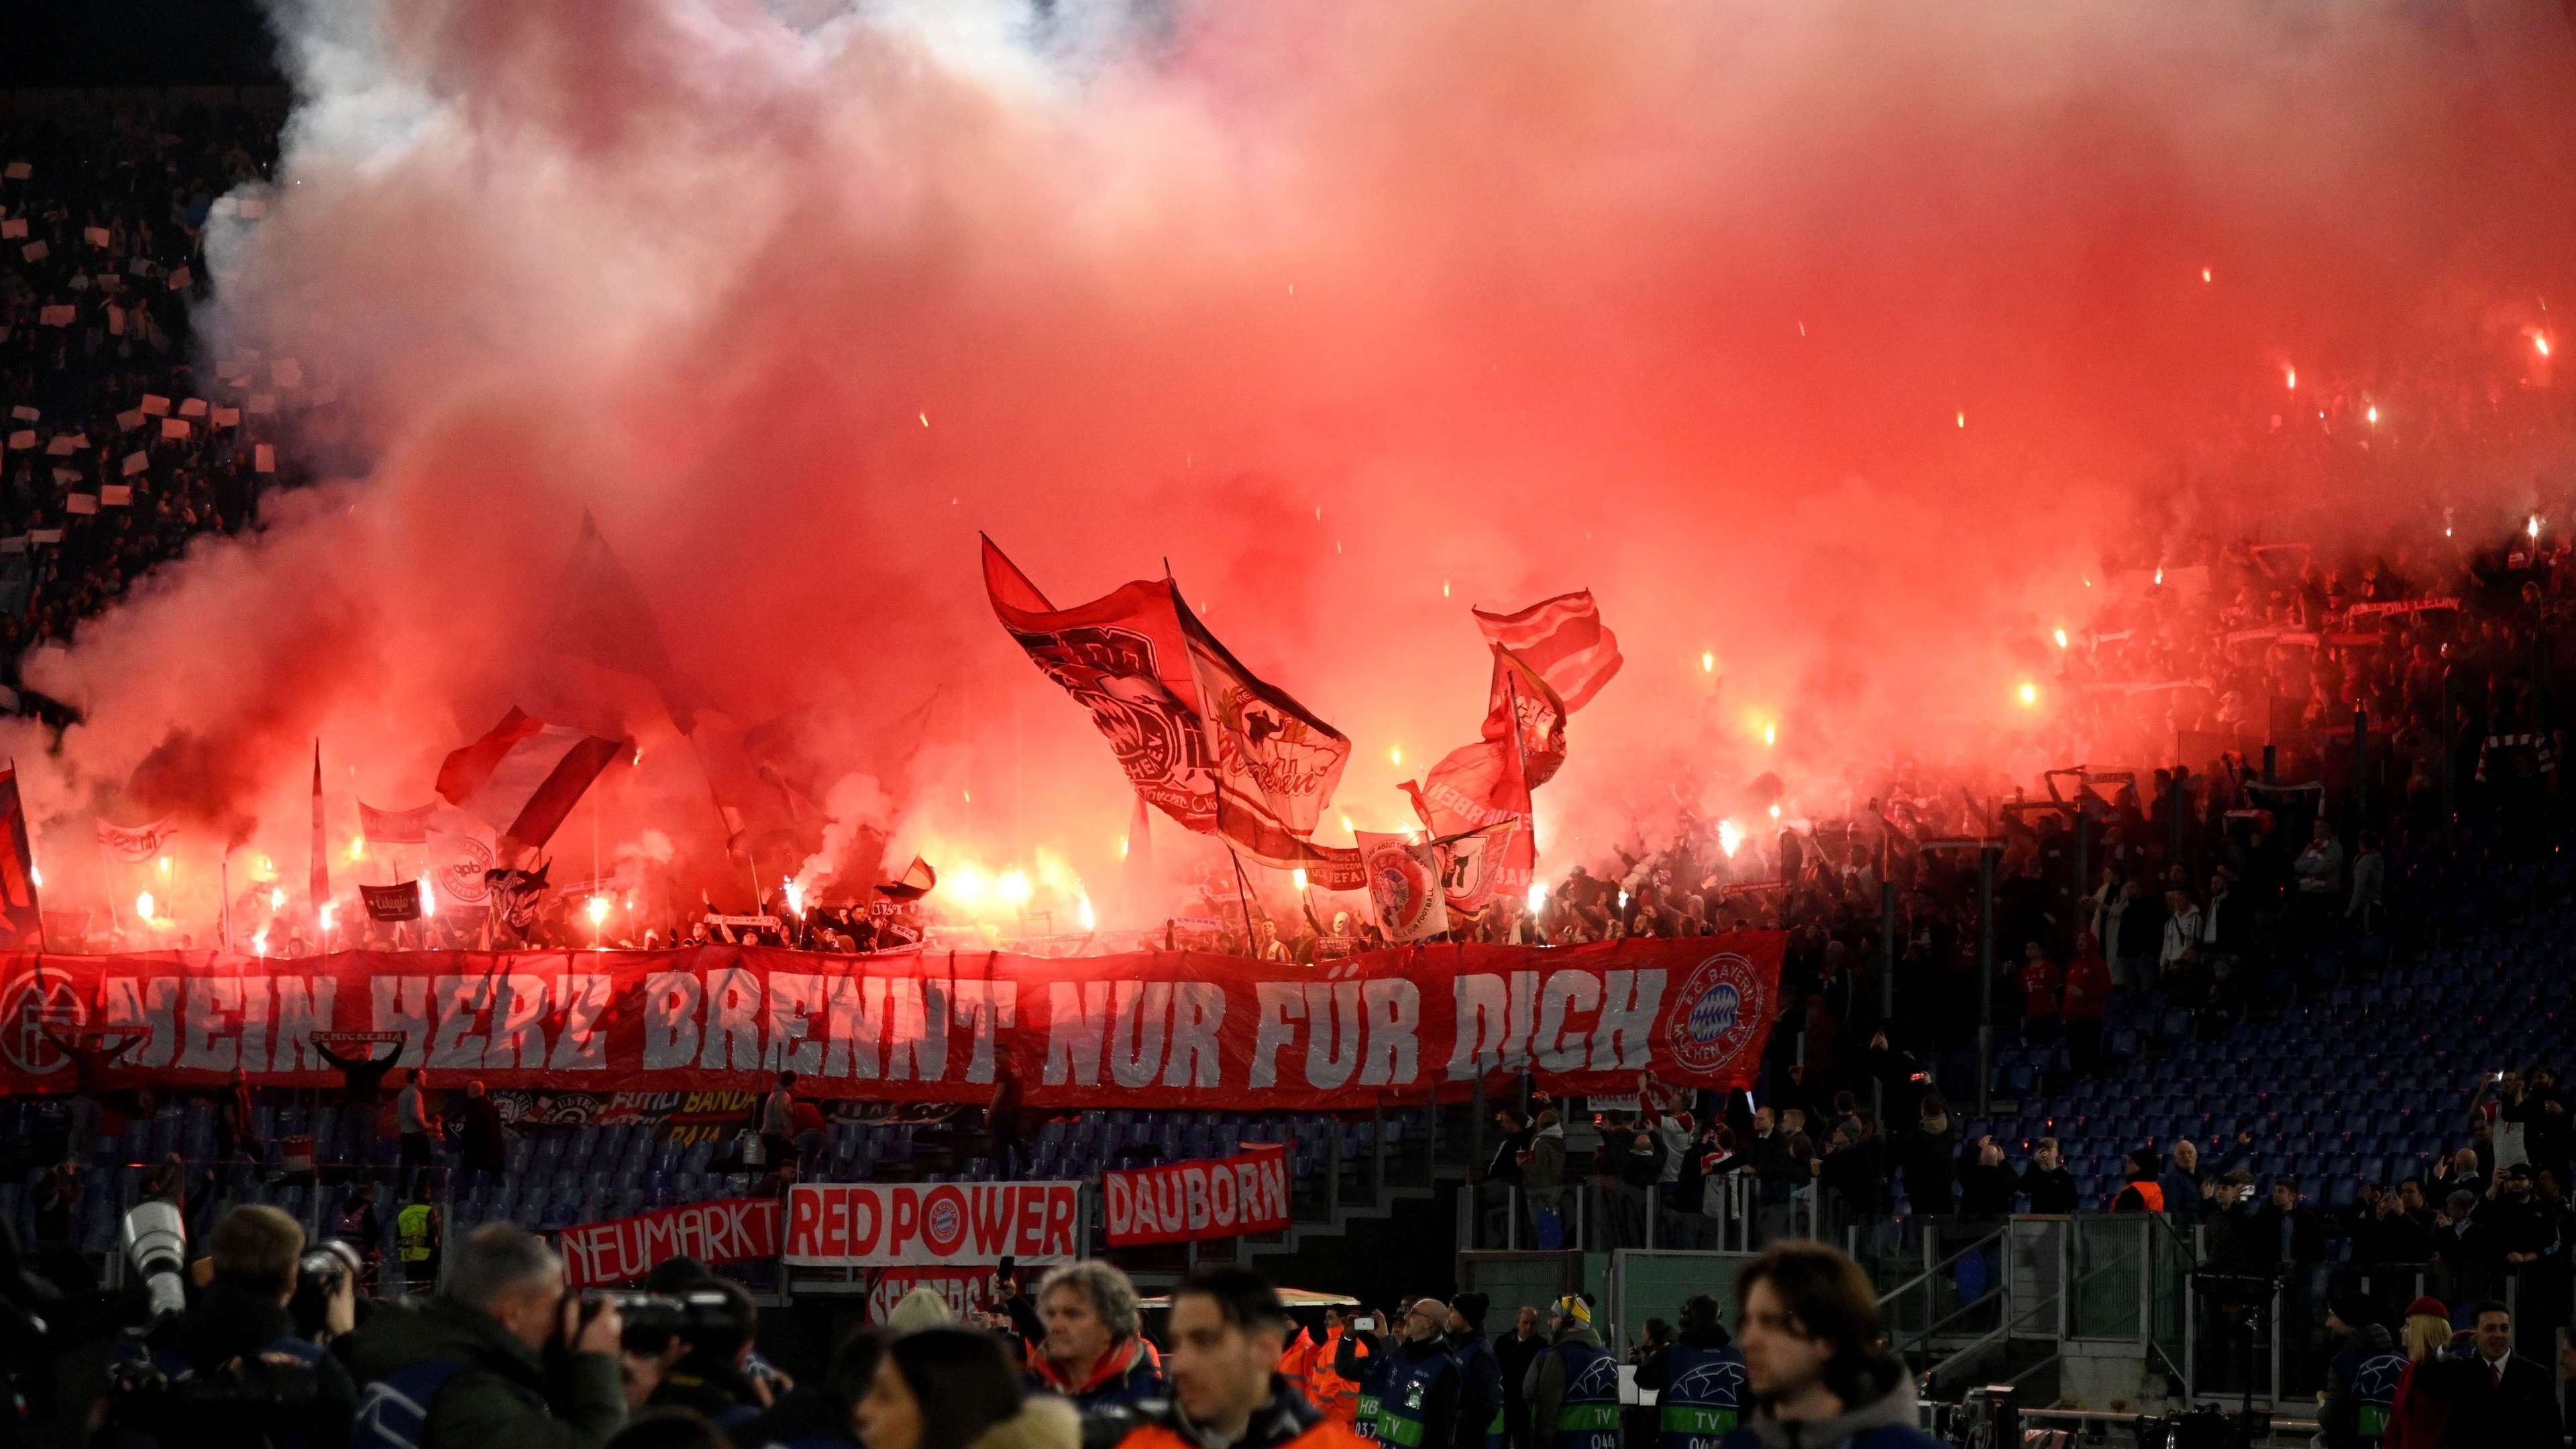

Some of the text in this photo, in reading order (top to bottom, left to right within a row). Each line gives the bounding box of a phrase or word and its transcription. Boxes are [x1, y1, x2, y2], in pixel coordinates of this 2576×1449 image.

[1417, 888, 1434, 924] FOOTBALL
[1709, 965, 1754, 1002] BAYERN
[106, 975, 337, 1071] MEIN
[370, 973, 612, 1071] HERZ
[643, 968, 1018, 1084] BRENNT
[1042, 980, 1226, 1088] NUR
[1249, 963, 1421, 1089] FÜR
[1447, 969, 1668, 1081] DICH
[311, 1032, 402, 1042] SCHICKERIA
[1108, 1158, 1288, 1236] DAUBORN
[786, 1188, 882, 1256] RED
[890, 1185, 1075, 1256] POWER
[559, 1201, 779, 1286] NEUMARKT
[1355, 1421, 1378, 1439] 037
[1383, 1415, 1401, 1437] TV
[1595, 1408, 1611, 1426] TV
[1695, 1412, 1720, 1430] TV
